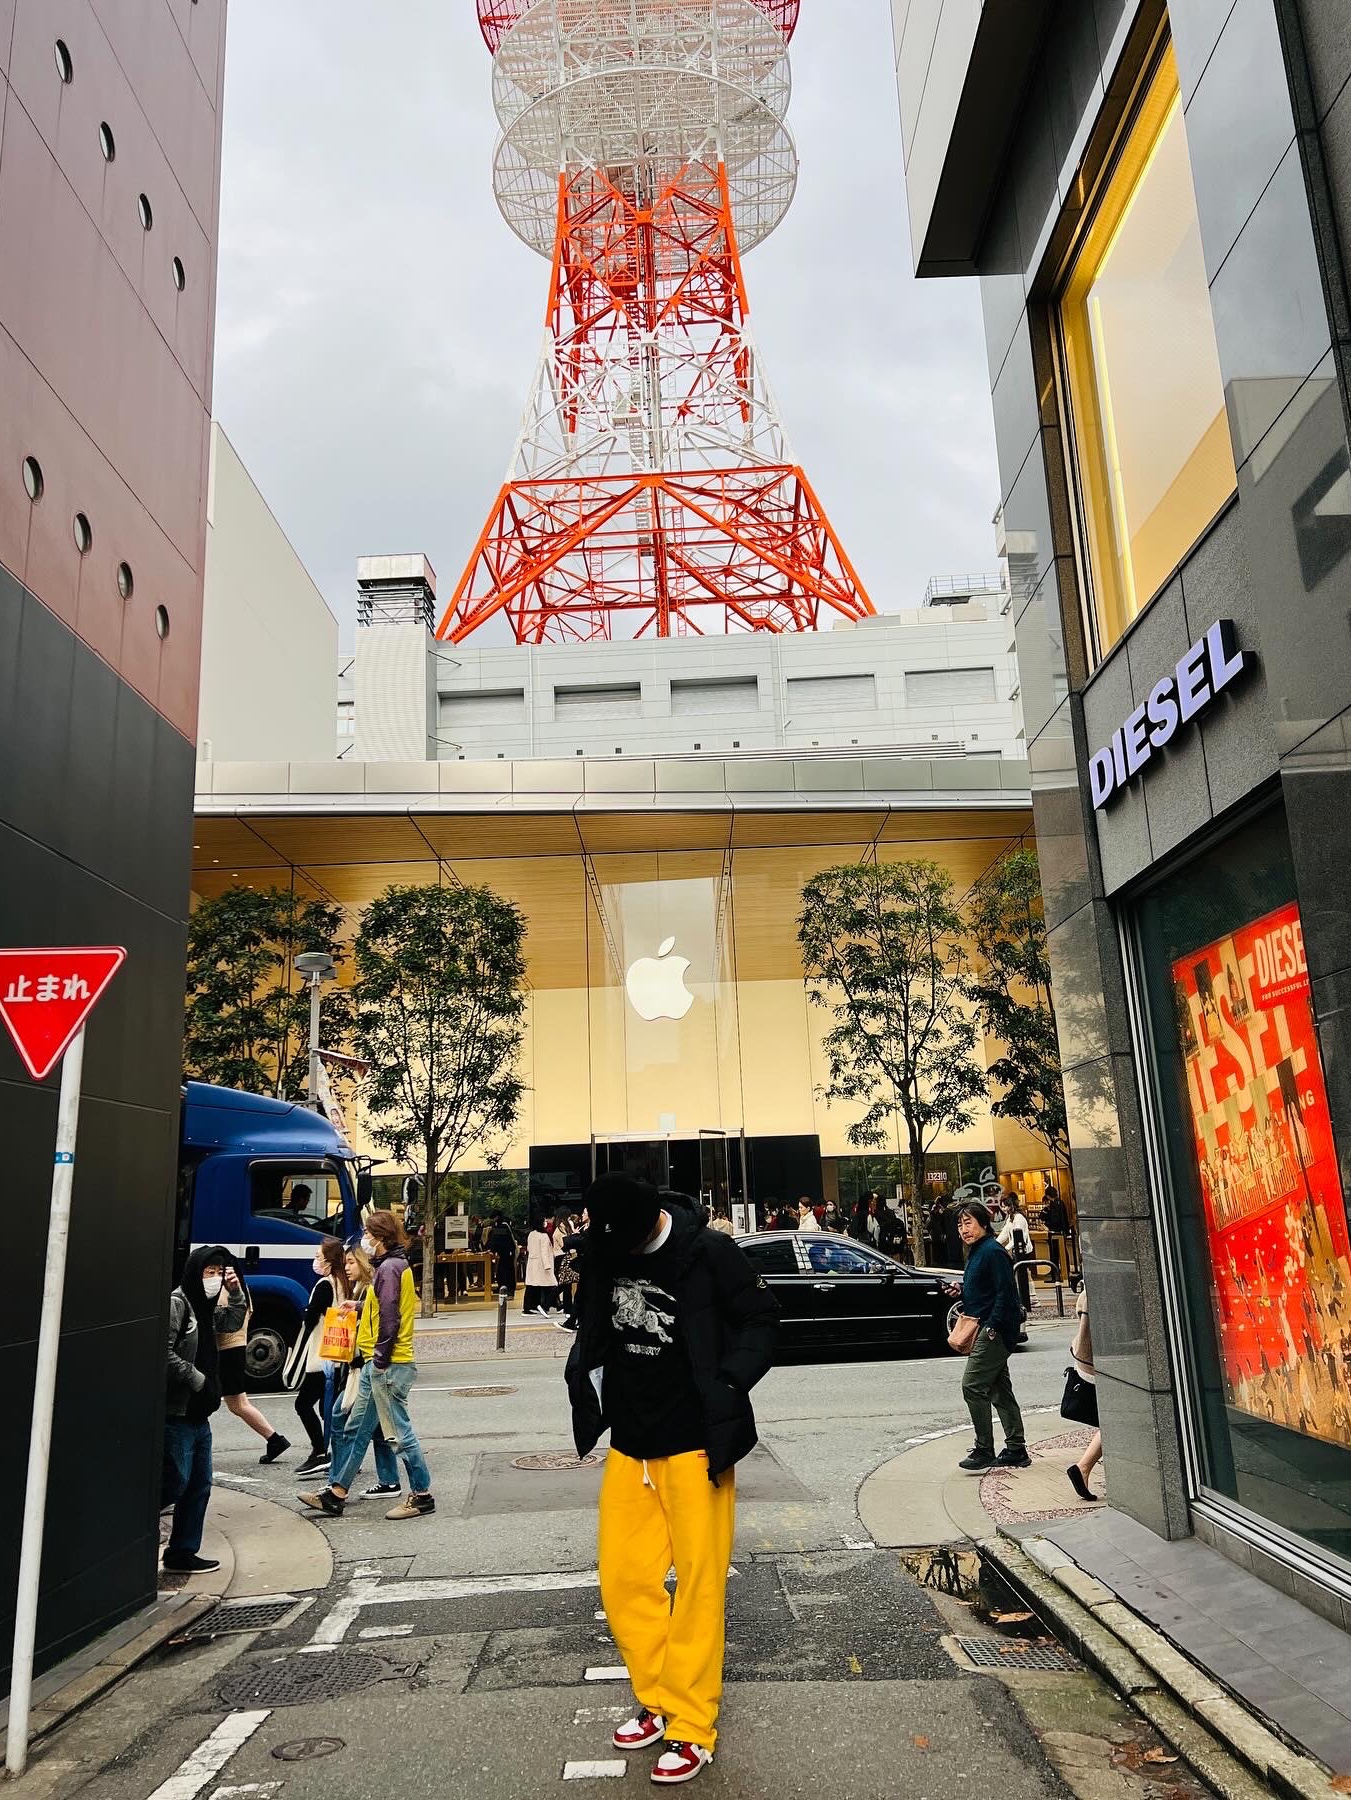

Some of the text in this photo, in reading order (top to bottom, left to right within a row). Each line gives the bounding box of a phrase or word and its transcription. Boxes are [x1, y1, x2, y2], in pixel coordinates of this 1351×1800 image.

[1089, 619, 1247, 809] DIESEL
[1255, 919, 1308, 988] DIESE
[3, 973, 91, 1002] 止まれ
[1272, 981, 1303, 997] SUCCESSFUL
